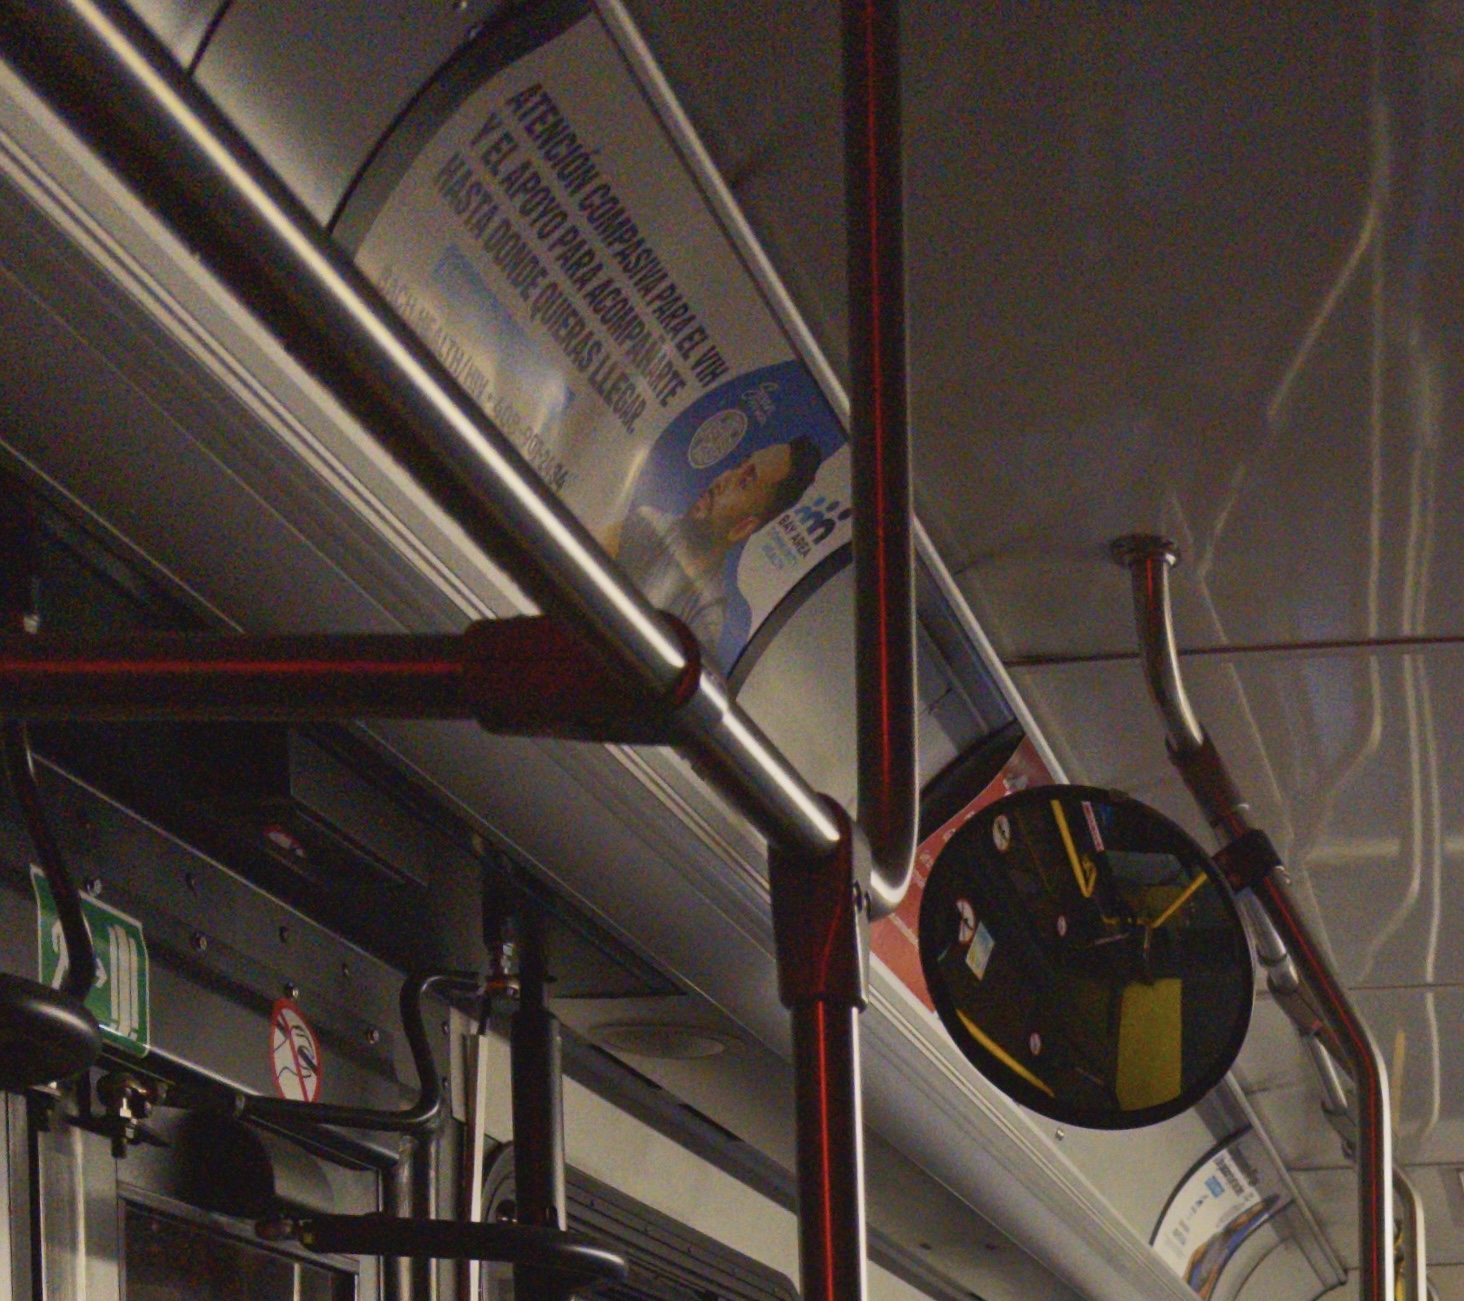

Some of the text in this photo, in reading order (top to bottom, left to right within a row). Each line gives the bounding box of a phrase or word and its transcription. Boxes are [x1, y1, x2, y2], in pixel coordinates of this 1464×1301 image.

[429, 154, 503, 238] HASTA
[480, 220, 550, 301] DONDE
[527, 282, 604, 373] QUIERAS
[585, 356, 648, 434] LLEGAR.
[466, 113, 689, 408] Y EL APOYO PARA ACOMPAÑARTE
[503, 79, 729, 388] ATENCIÓN COMPASIVA PARA EL VIH
